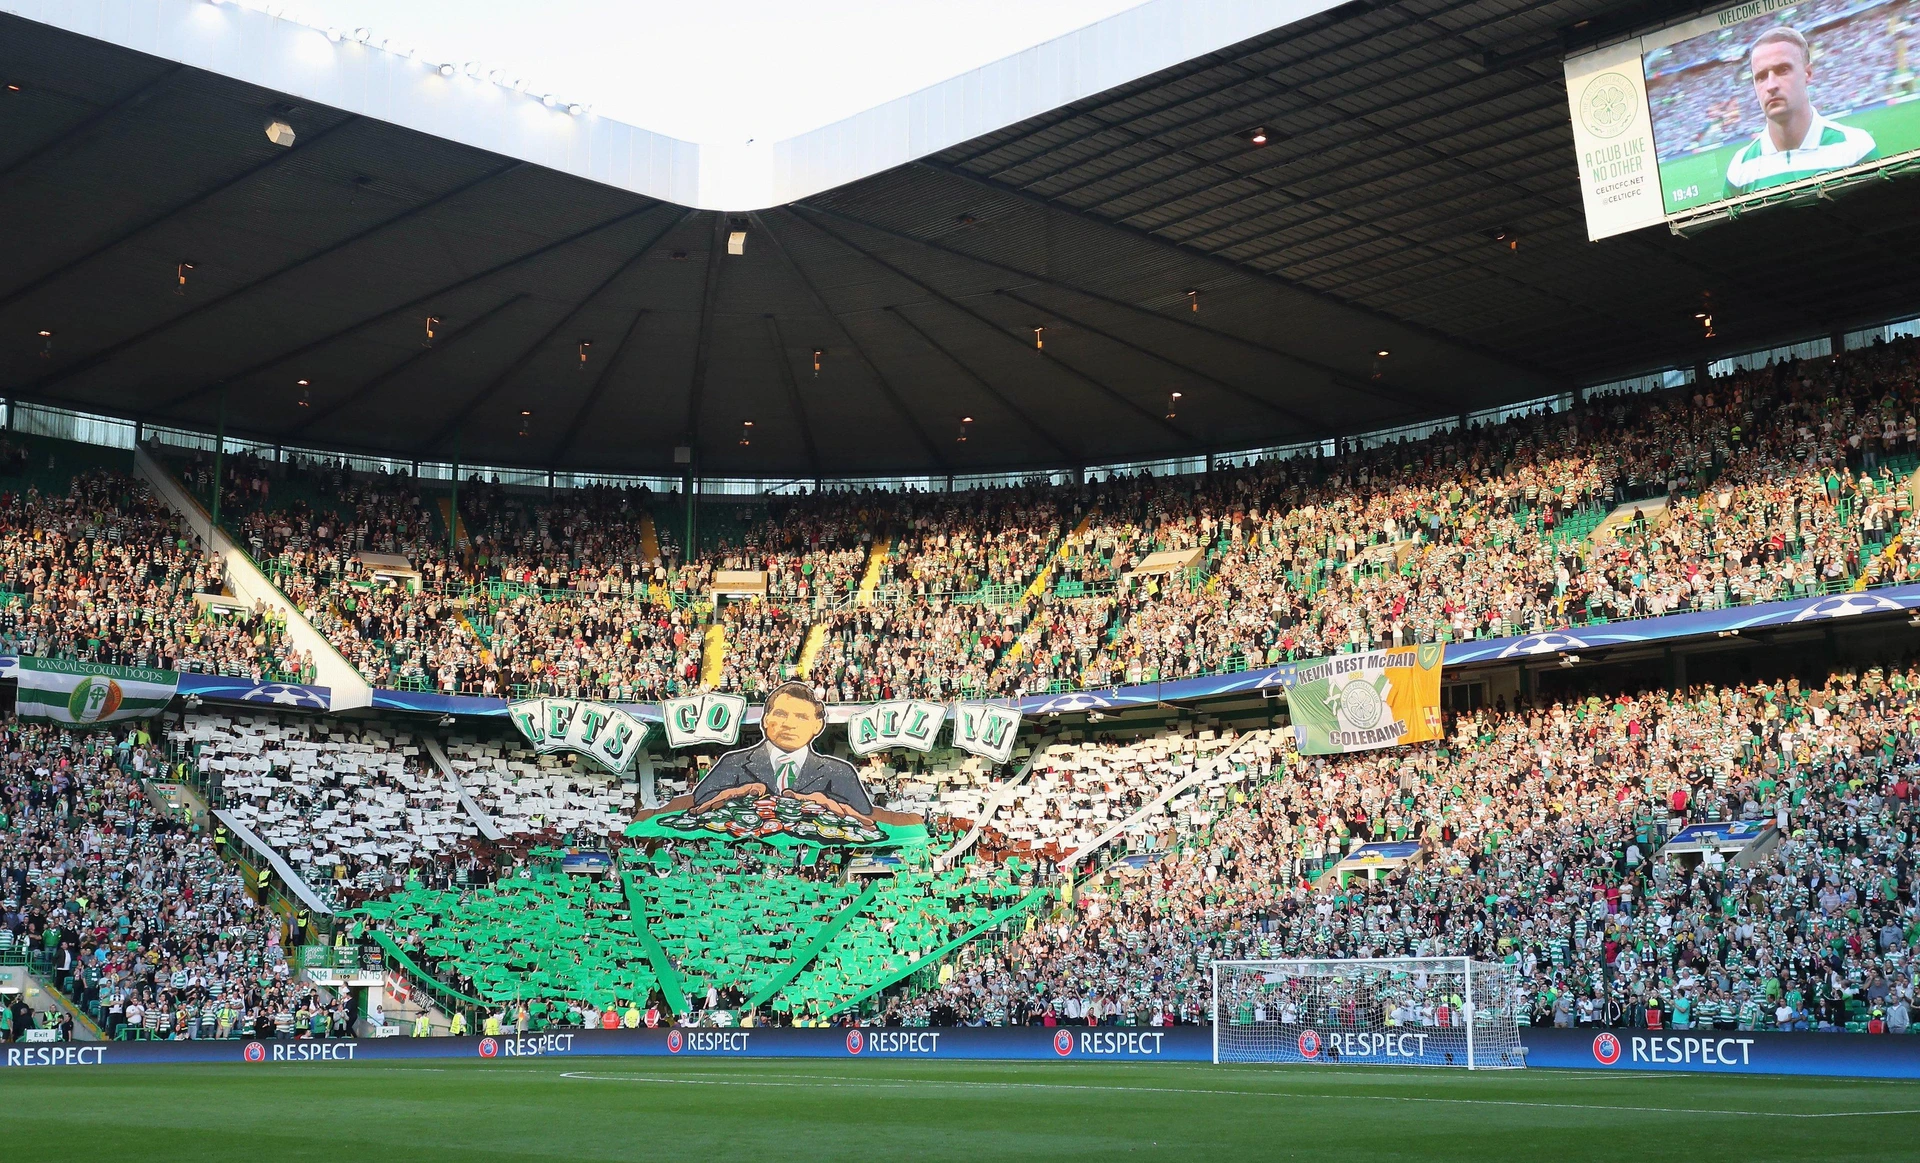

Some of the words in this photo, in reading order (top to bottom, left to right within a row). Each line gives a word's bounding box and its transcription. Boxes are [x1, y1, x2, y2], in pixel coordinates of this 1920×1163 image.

[1718, 3, 1762, 26] WELCOME
[1764, 0, 1774, 12] TO
[1598, 76, 1624, 85] FOOTBALL
[1585, 152, 1593, 168] A
[1595, 144, 1622, 166] CLUB
[1624, 137, 1646, 157] LIKE
[1592, 166, 1608, 183] NO
[1610, 156, 1643, 176] OTHER
[1596, 176, 1645, 195] CELTICFC.NET
[1672, 185, 1699, 202] 19:43
[1602, 189, 1642, 205] @CELTICFC
[36, 659, 121, 676] RANDALSTOWN
[1298, 662, 1333, 685] KEVIN
[1336, 656, 1366, 674] BEST
[1368, 652, 1416, 669] McDAID
[517, 705, 633, 760] LETS
[675, 703, 731, 734] GO
[857, 709, 931, 744] ALL
[964, 712, 1013, 750] IN
[1330, 720, 1408, 746] COLERAINE
[688, 1032, 750, 1051] RESPECT
[869, 1032, 940, 1052] RESPECT
[1058, 1030, 1069, 1038] UEFA
[1080, 1032, 1164, 1054] RESPECT
[1303, 1030, 1316, 1038] UEFA
[1597, 1034, 1614, 1042] UEFA
[273, 1043, 358, 1061] RESPECT
[505, 1034, 574, 1056] RESPECT
[1330, 1032, 1428, 1057] RESPECT
[1631, 1036, 1754, 1065] RESPECT
[8, 1046, 107, 1066] RESPECT
